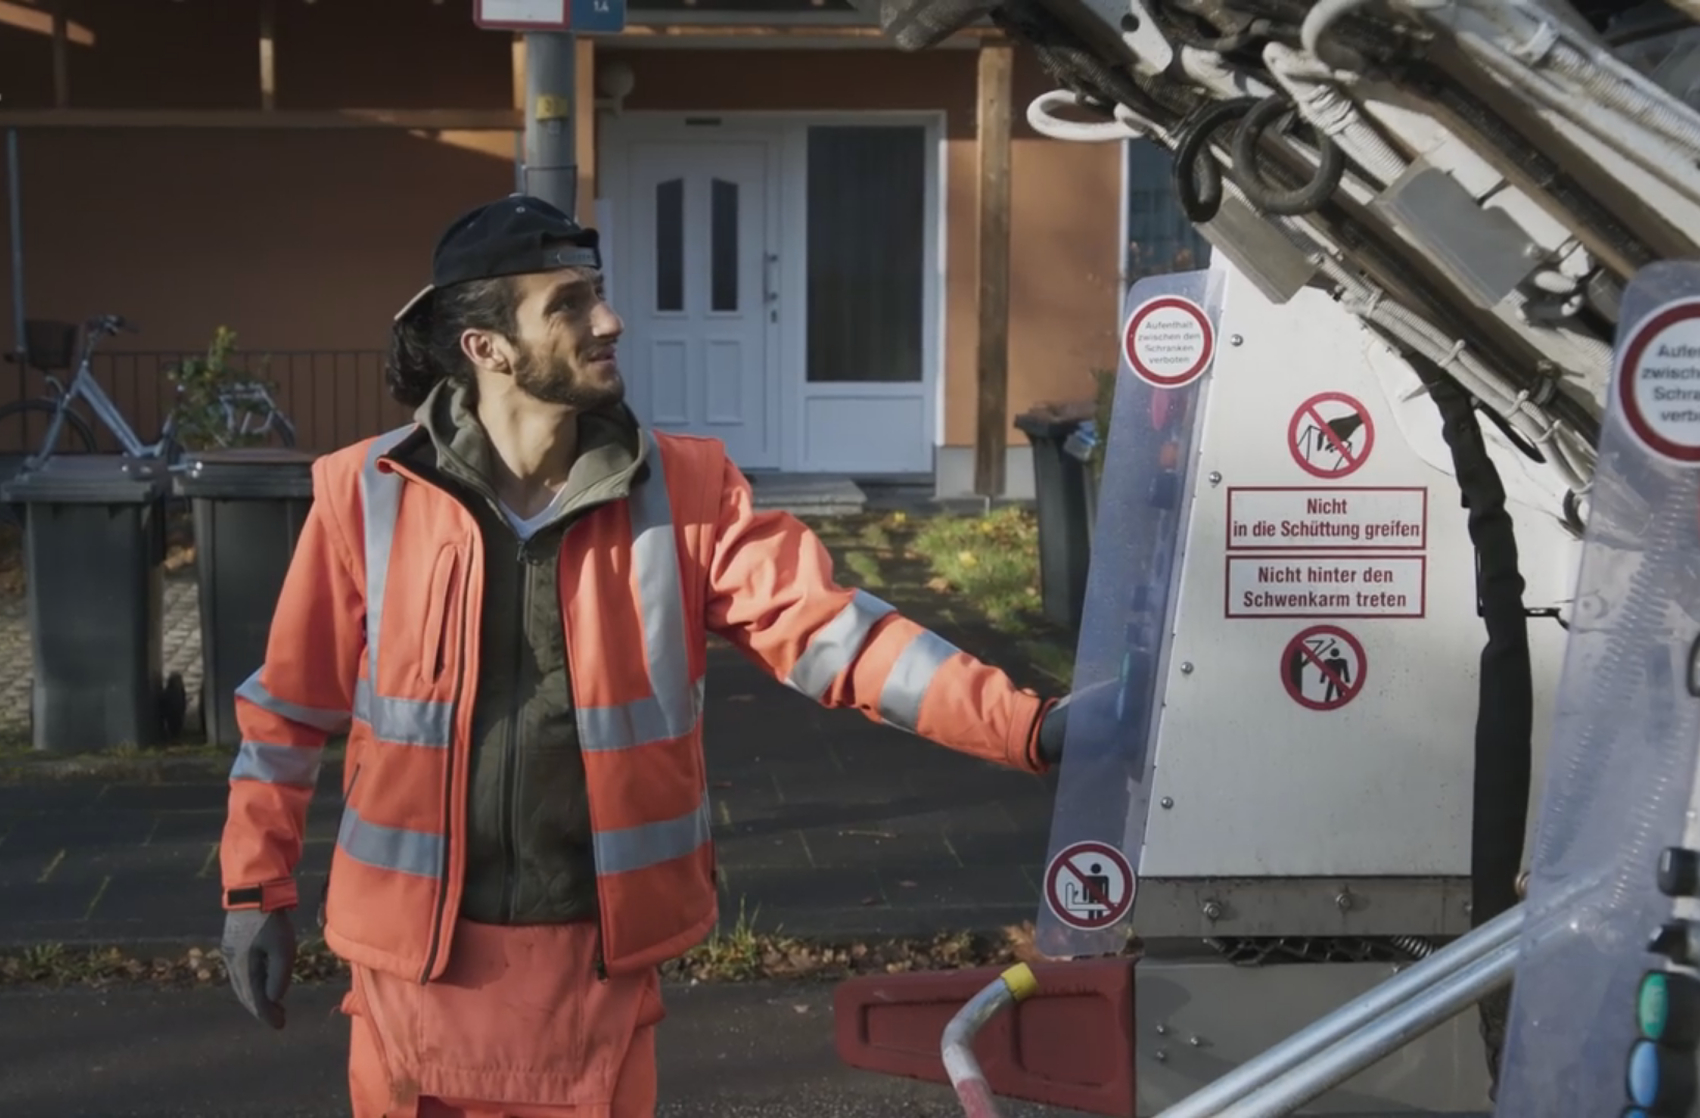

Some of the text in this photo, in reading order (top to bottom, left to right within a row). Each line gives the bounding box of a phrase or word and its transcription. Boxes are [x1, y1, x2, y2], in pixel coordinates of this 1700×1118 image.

[1145, 321, 1193, 330] Aufenthalt
[1138, 332, 1201, 342] zwischen den
[1144, 344, 1194, 352] Schranken
[1658, 344, 1700, 358] Aufe
[1149, 356, 1189, 364] verboten
[1661, 410, 1700, 422] verb
[1306, 498, 1347, 515] Nicht
[1233, 520, 1420, 540] in die Schüttung greifen
[1258, 566, 1393, 583] Nicht hinter den
[1243, 591, 1407, 608] Schwenkarm treten
